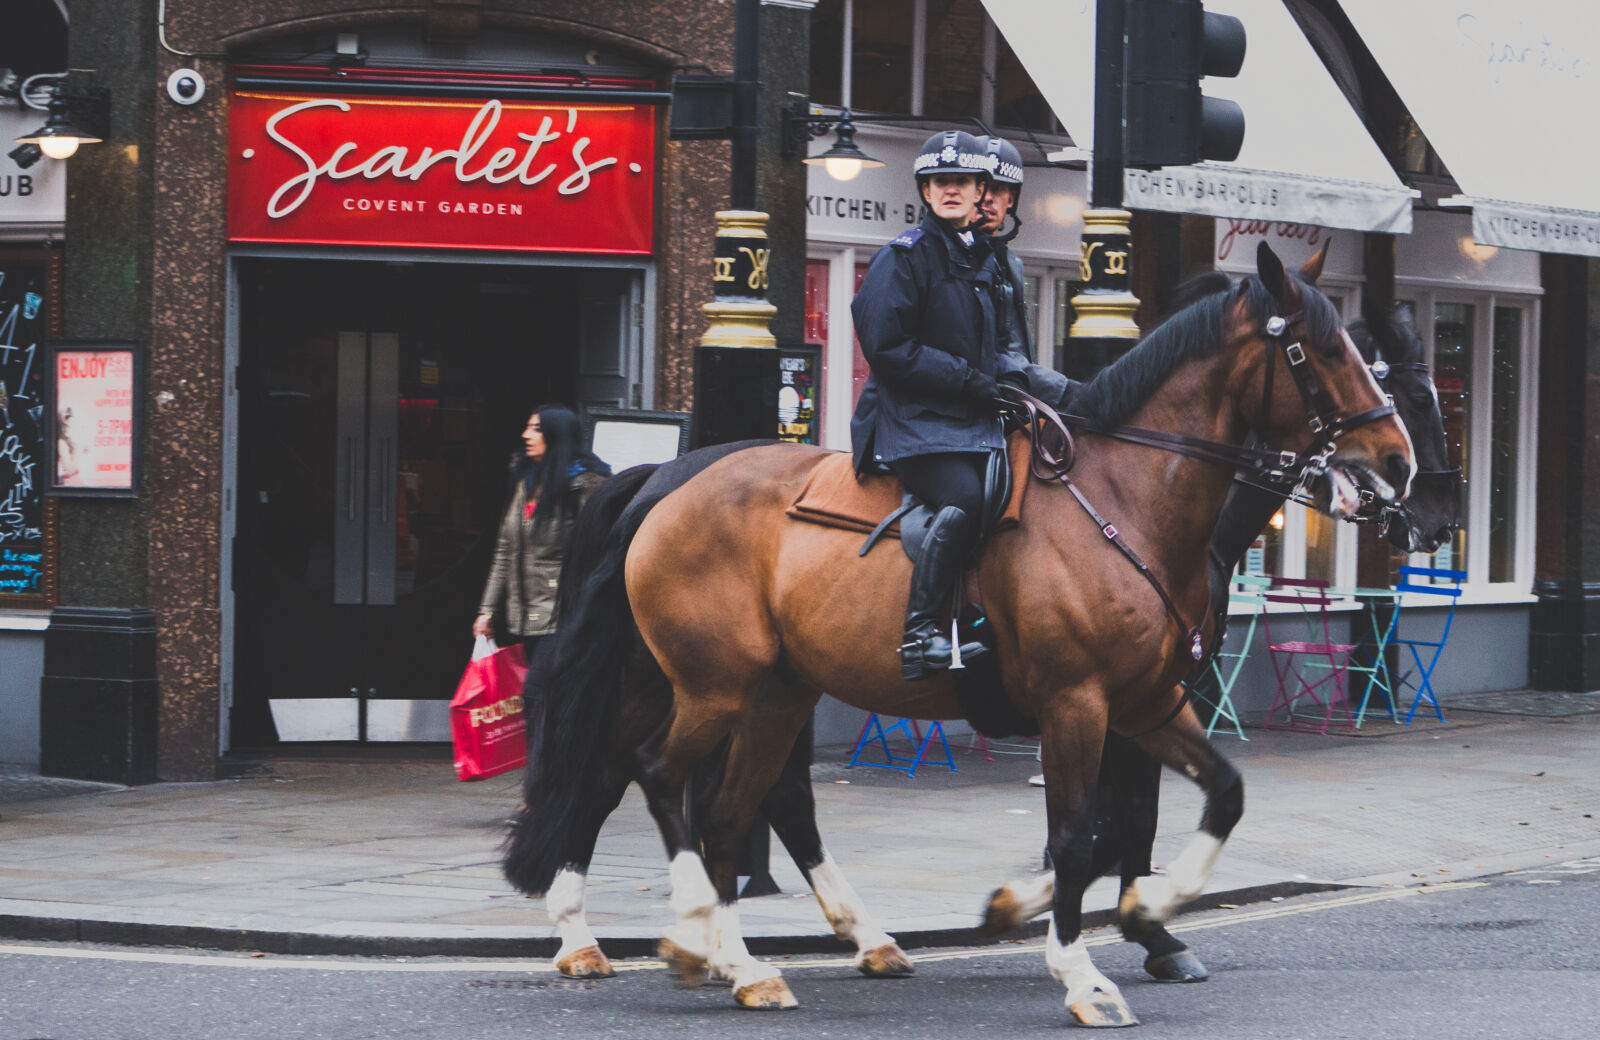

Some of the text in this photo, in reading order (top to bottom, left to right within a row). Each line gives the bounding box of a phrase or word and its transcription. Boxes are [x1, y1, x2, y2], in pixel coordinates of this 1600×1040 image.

[265, 99, 618, 218] Scarlet's
[0, 175, 33, 197] UB
[1128, 173, 1185, 197] TCHEN
[343, 198, 523, 215] COVENT GARDEN
[806, 195, 927, 224] KITCHEN BA
[1488, 216, 1547, 238] KTCHEN
[61, 357, 108, 379] ENJOY
